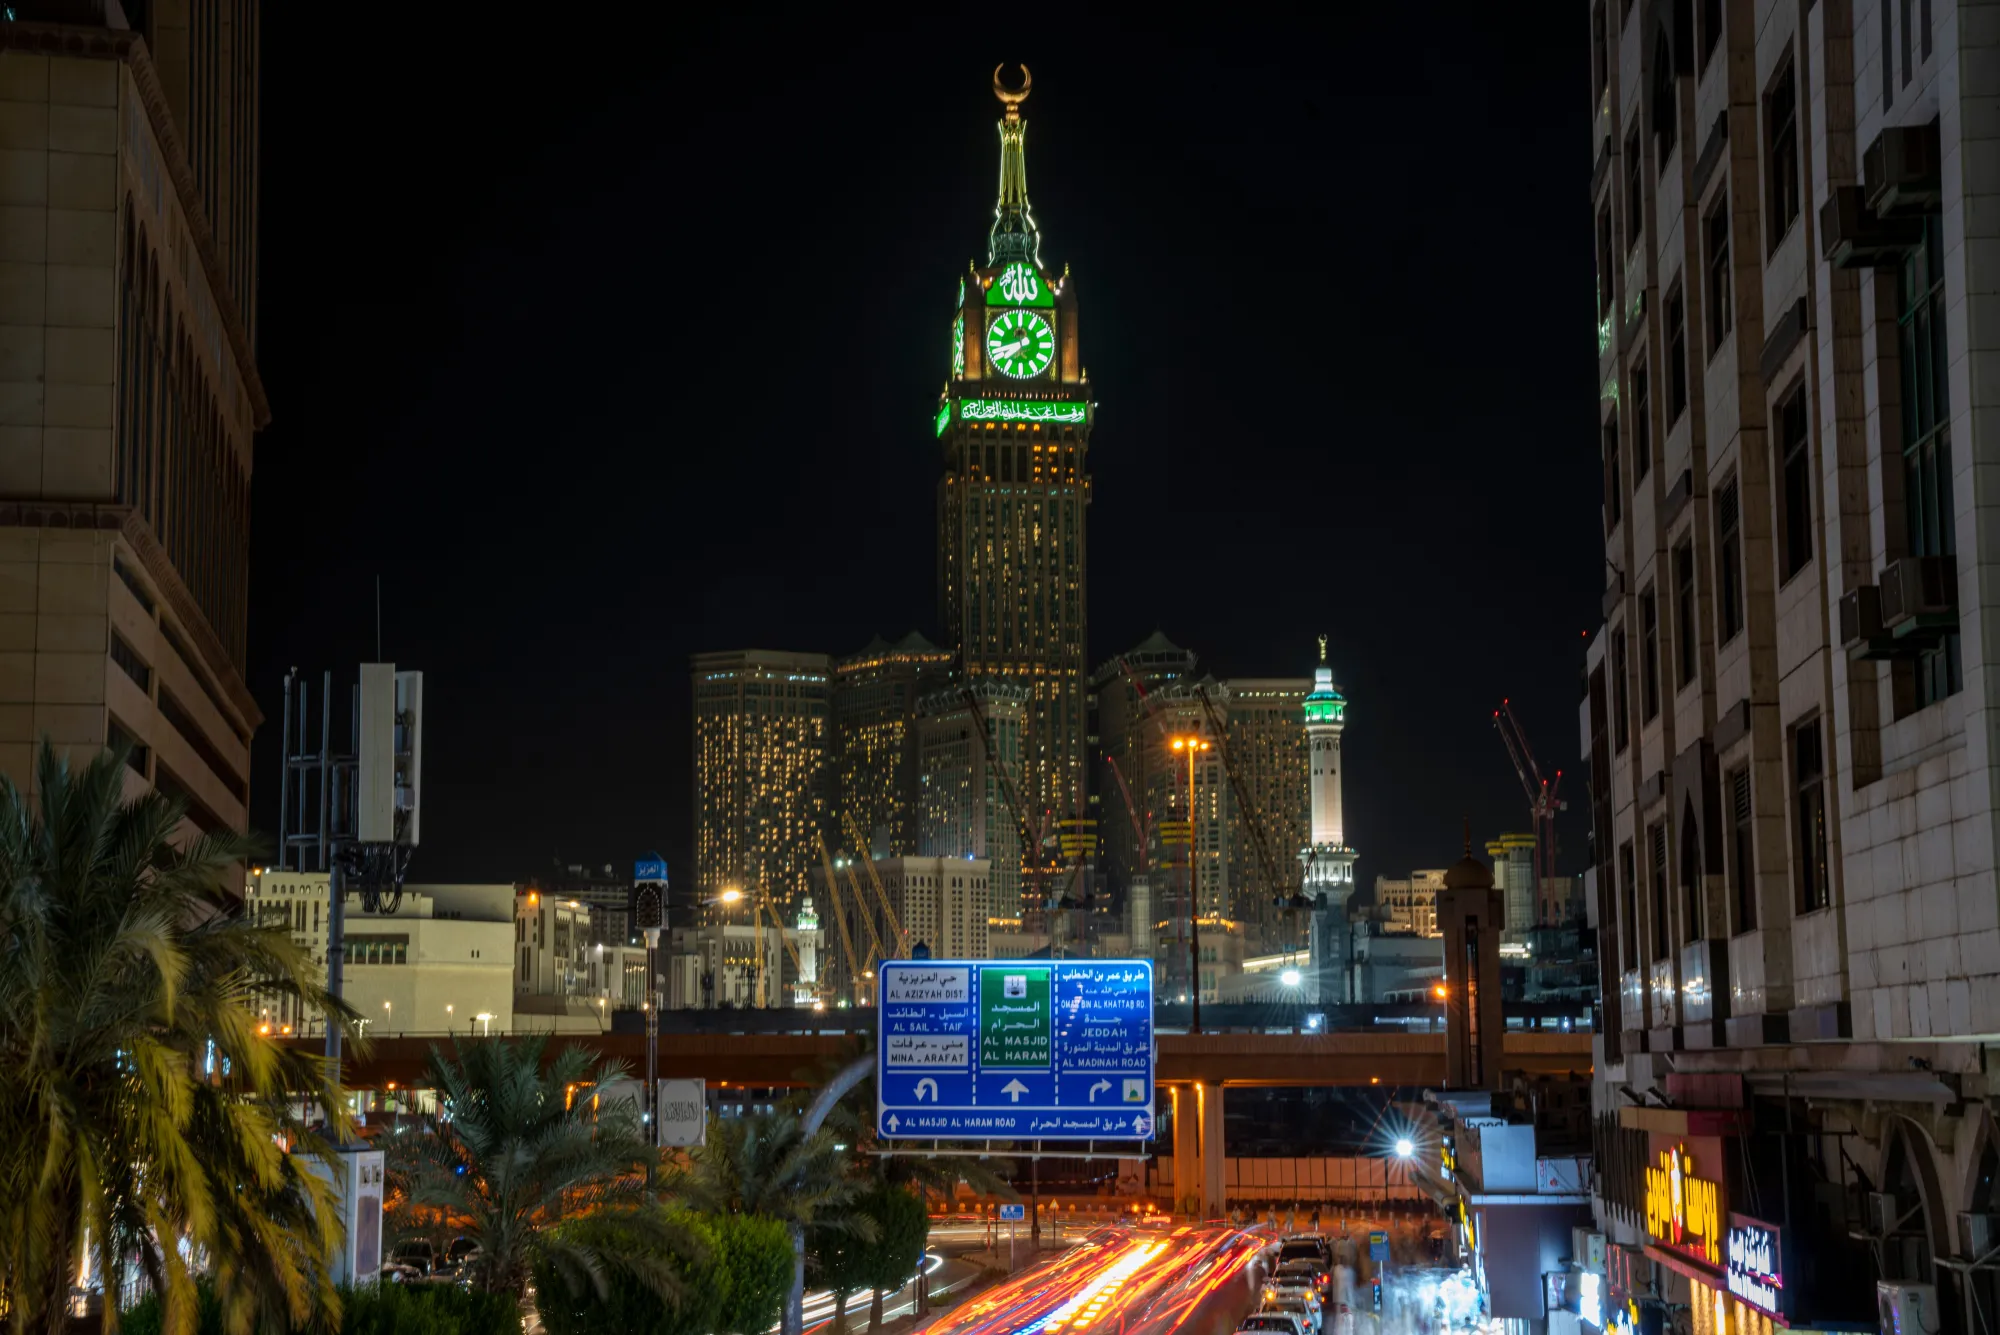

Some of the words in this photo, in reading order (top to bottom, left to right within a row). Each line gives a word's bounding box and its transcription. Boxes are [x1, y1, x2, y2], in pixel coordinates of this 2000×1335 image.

[898, 972, 938, 985] العزيزية
[940, 975, 957, 987] حي
[1062, 968, 1093, 982] الخطاب
[1094, 971, 1104, 982] بن
[1106, 972, 1120, 981] عمر
[1122, 969, 1144, 982] طريق
[890, 990, 900, 998] AL
[905, 990, 942, 998] AZIZYAH
[946, 990, 966, 998] DIST.
[1100, 985, 1112, 994] الله
[991, 1000, 1040, 1015] المسجد
[1081, 1000, 1092, 1008] BIN
[1093, 1000, 1102, 1008] AL
[1104, 1000, 1135, 1009] KHATTAB
[887, 1007, 926, 1018] الطائف
[939, 1007, 969, 1020] السيل
[1084, 1013, 1122, 1025] جدة
[893, 1022, 905, 1032] AL
[910, 1022, 930, 1032] SAIL
[943, 1022, 963, 1032] TAIF
[991, 1018, 1040, 1034] الحرام
[1081, 1028, 1128, 1038] JEDDAH
[892, 1036, 927, 1051] عرفات
[983, 1036, 999, 1046] AL
[1004, 1036, 1048, 1046] MASJID
[1063, 1041, 1092, 1055] المنورة
[1094, 1041, 1121, 1055] المدينة
[891, 1053, 914, 1063] MINA
[924, 1053, 964, 1063] ARAFAT
[984, 1051, 999, 1060] AL
[1005, 1051, 1048, 1060] HARAM
[1062, 1058, 1074, 1068] AL
[1078, 1058, 1118, 1068] MADINAH
[1121, 1058, 1147, 1068] ROAD
[905, 1118, 916, 1127] AL
[919, 1117, 948, 1127] MASJID
[951, 1118, 961, 1127] AL
[964, 1118, 993, 1127] HARAM
[995, 1118, 1016, 1127] ROAD
[1030, 1117, 1061, 1132] الحرام
[1062, 1117, 1100, 1130] المسجد
[1102, 1117, 1127, 1131] طريق
